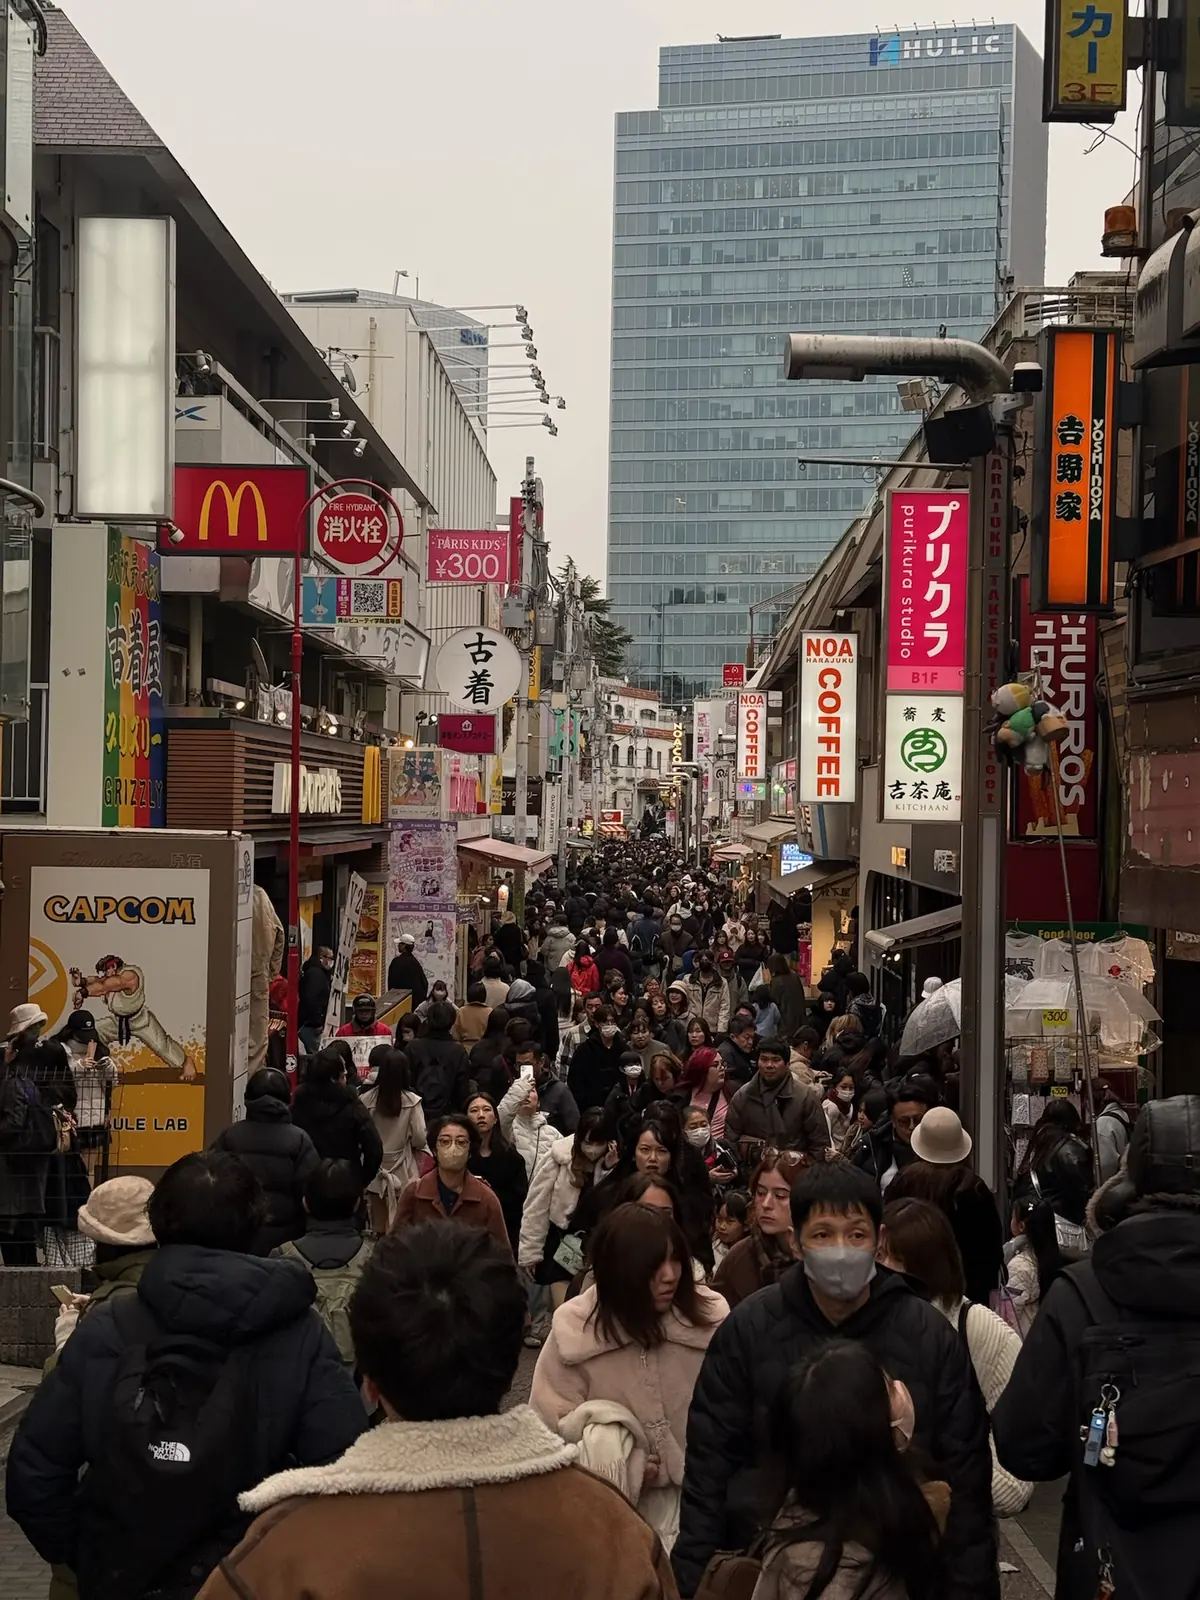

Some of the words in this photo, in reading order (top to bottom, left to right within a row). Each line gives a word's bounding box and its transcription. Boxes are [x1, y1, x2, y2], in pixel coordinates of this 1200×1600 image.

[903, 33, 1001, 60] HULIC
[1063, 82, 1118, 103] 3F
[1056, 414, 1085, 521] 吉野家
[1090, 418, 1104, 520] YOSHINOYA
[329, 503, 344, 511] FIRE
[346, 504, 376, 512] HYDRANT
[323, 515, 383, 543] 消火栓
[437, 536, 469, 550] PARIS
[471, 539, 501, 551] KID'S
[900, 505, 916, 589] purikura
[436, 553, 499, 579] ¥300
[923, 500, 960, 658] プリクラ
[900, 597, 915, 659] studio
[106, 601, 162, 700] 古着屋
[806, 638, 853, 657] NOA
[463, 632, 497, 706] 古着
[910, 672, 939, 684] B1F
[740, 695, 764, 705] NOA
[902, 707, 946, 722] 蕎麦
[745, 709, 759, 777] COFFEE
[816, 667, 842, 797] COFFEE
[103, 776, 164, 808] GRIZZLY
[888, 780, 952, 801] 吉茶庵
[895, 803, 949, 812] KITCHAAN
[44, 895, 195, 925] CAPCOM
[1044, 1011, 1068, 1022] ¥300
[153, 1117, 188, 1131] LAB
[147, 1443, 176, 1456] NORTH
[153, 1452, 175, 1461] FACE
[160, 1441, 177, 1449] THE
